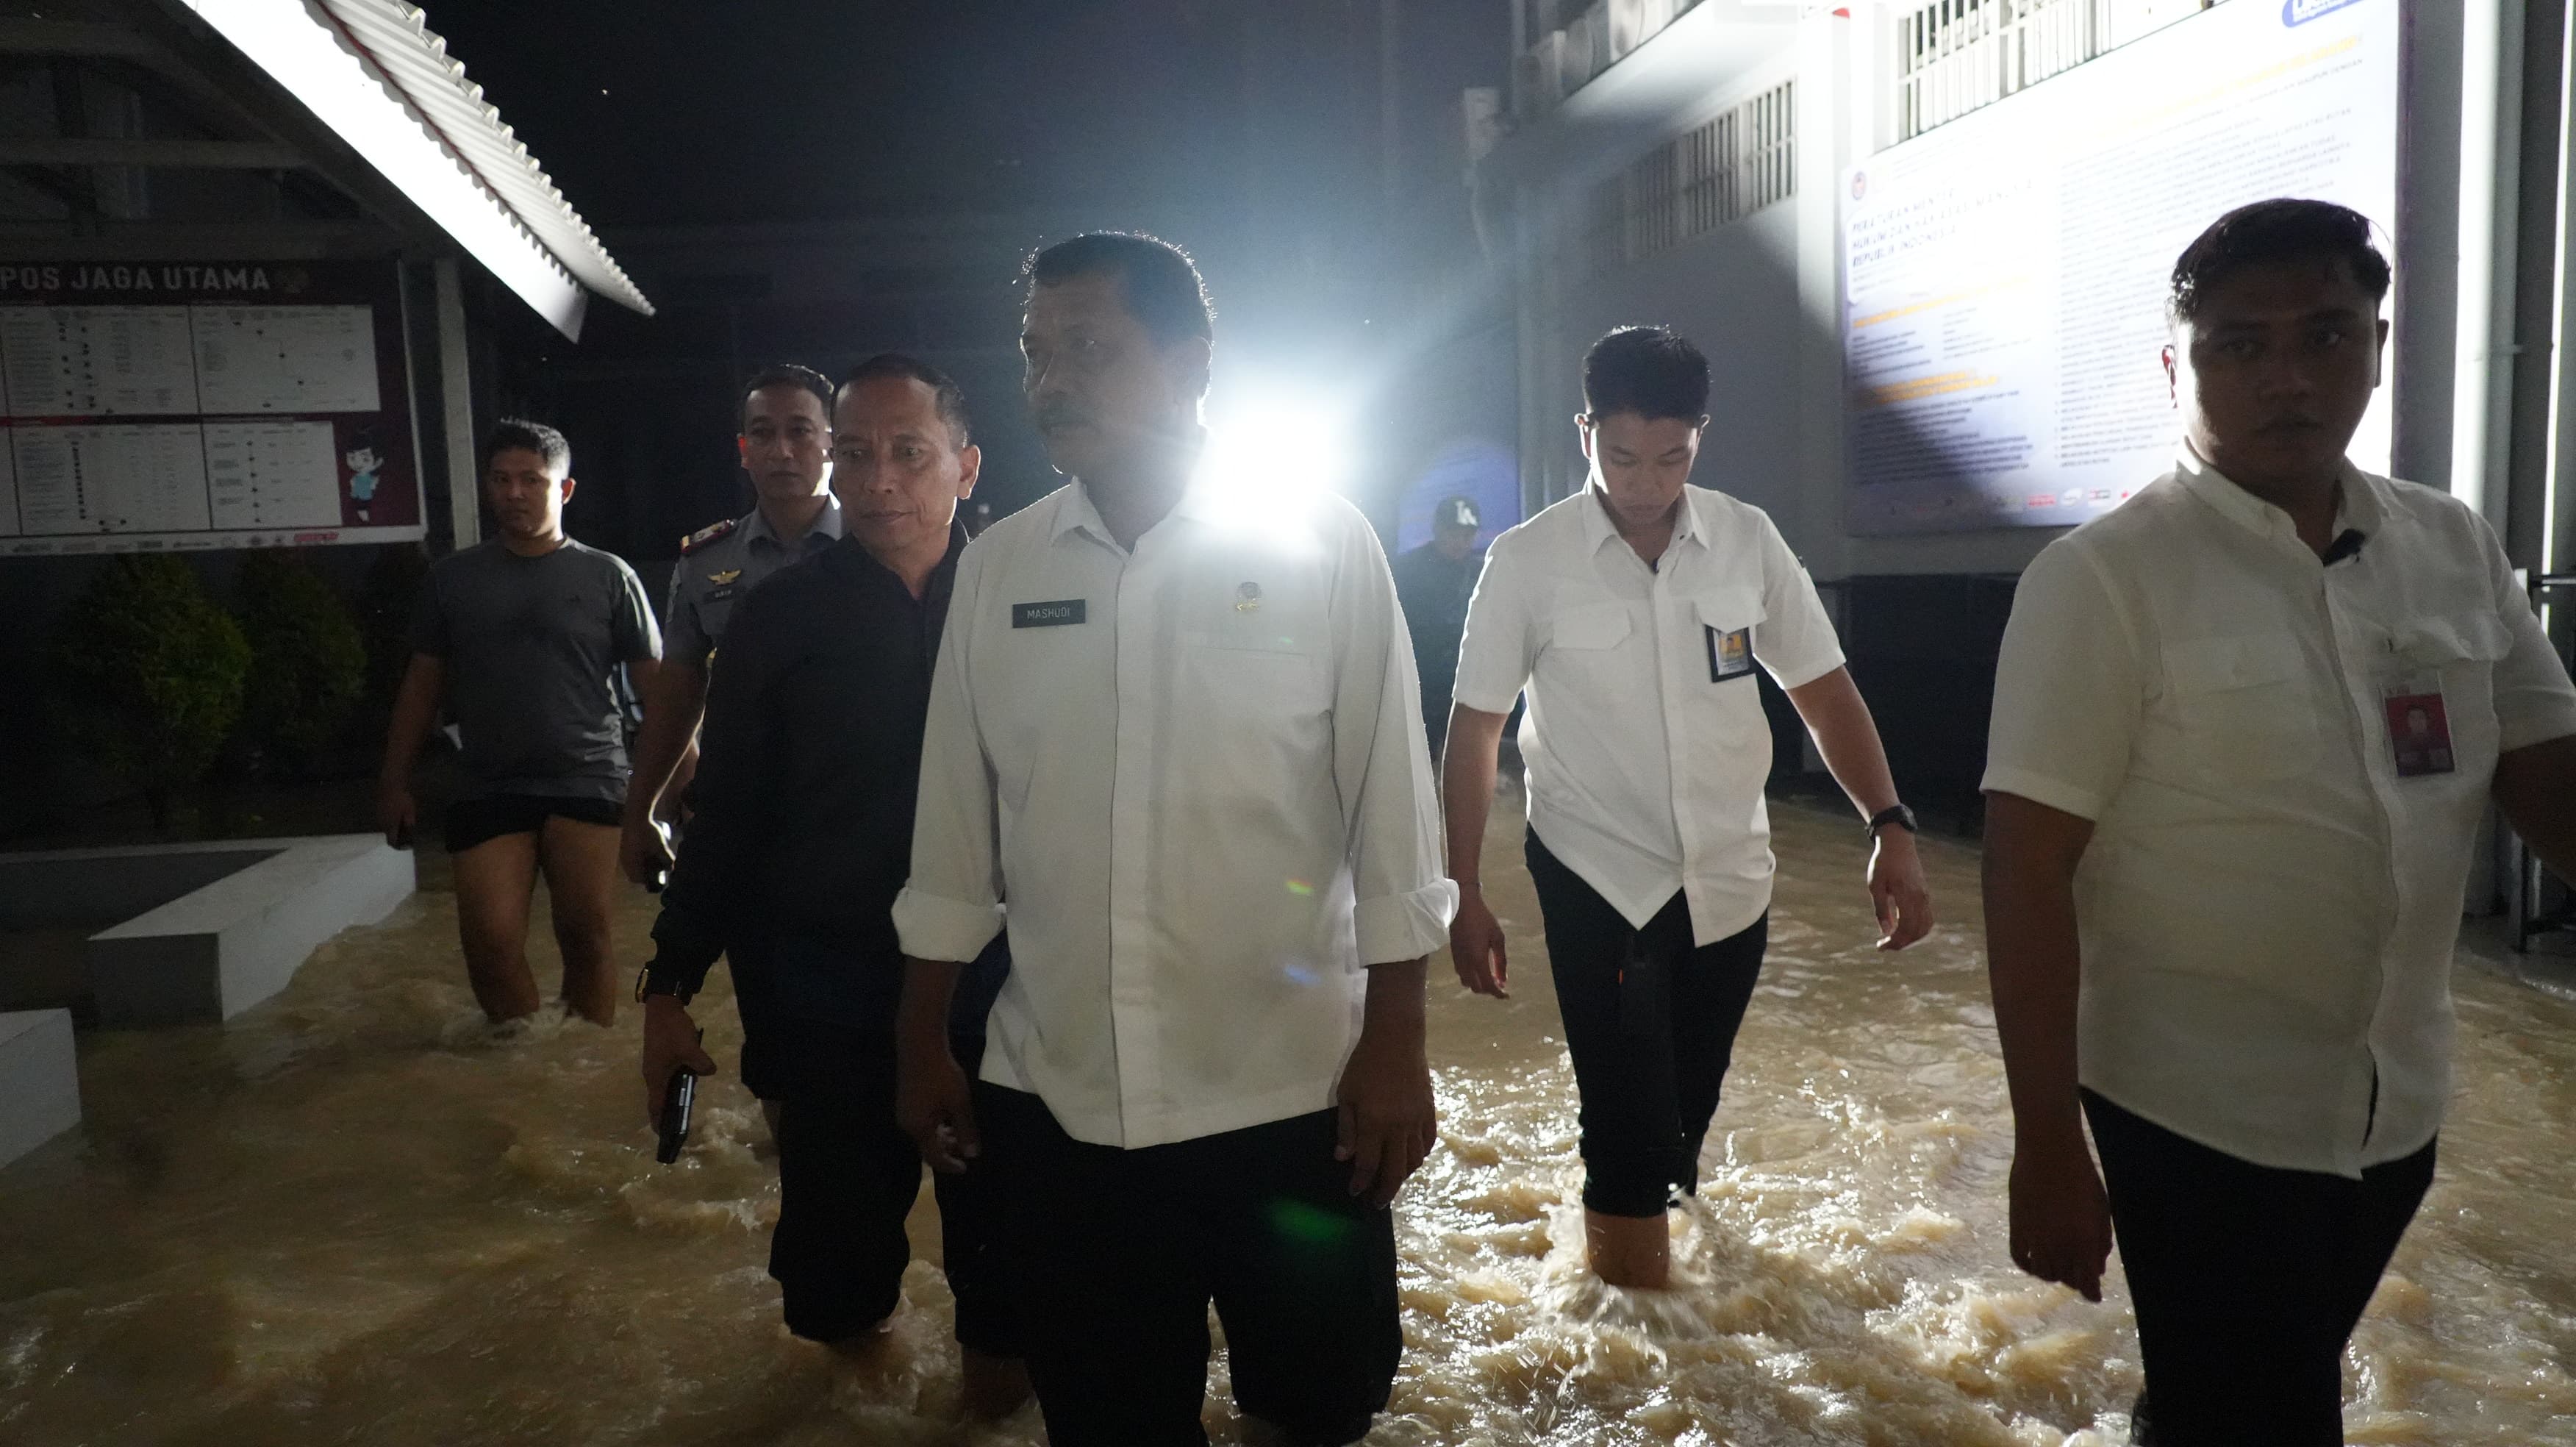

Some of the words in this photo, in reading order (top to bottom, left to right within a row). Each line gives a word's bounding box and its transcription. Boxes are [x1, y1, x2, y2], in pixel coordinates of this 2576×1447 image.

[0, 266, 60, 290] POS
[71, 266, 154, 290] JAGA
[163, 266, 271, 290] UTAMA
[1026, 607, 1071, 619] MASHUDI
